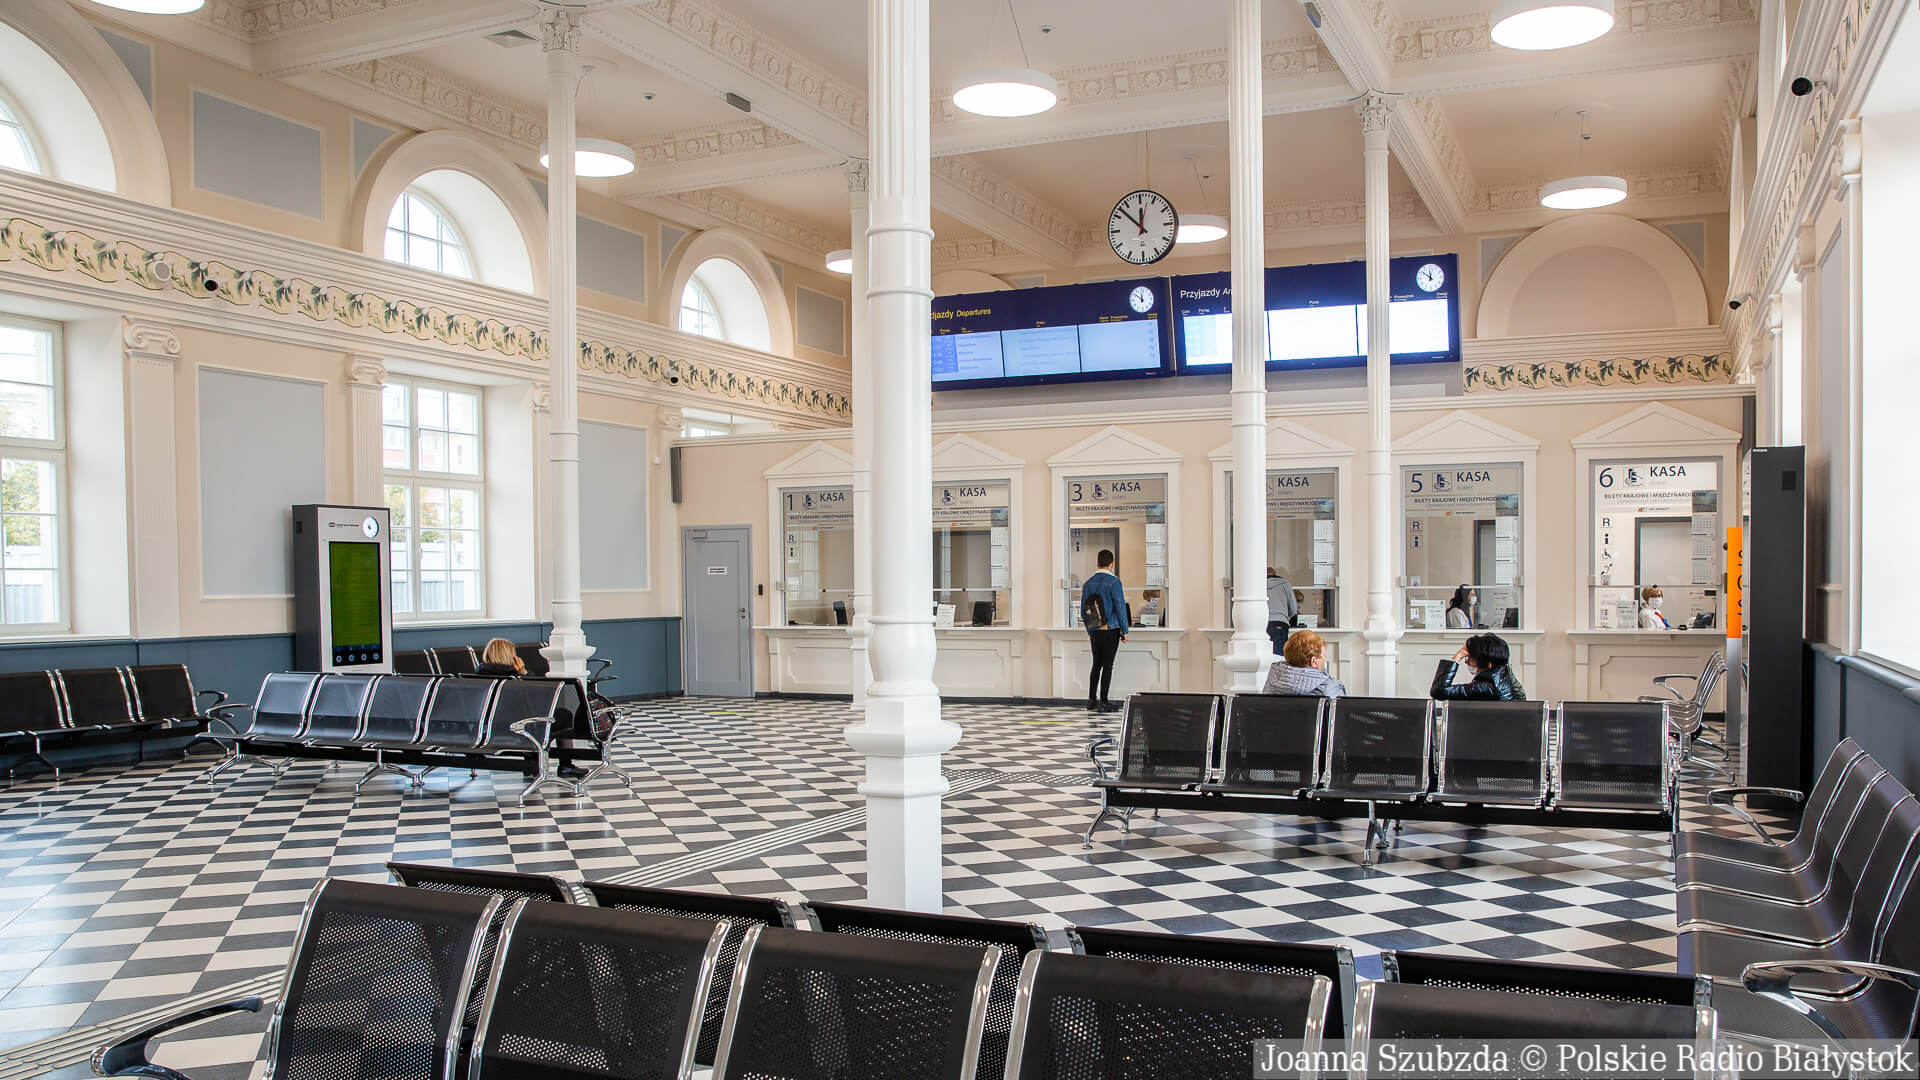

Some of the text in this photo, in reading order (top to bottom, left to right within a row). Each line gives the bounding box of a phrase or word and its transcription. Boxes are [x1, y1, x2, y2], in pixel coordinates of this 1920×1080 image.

[1180, 288, 1220, 300] Przyjazdy
[930, 308, 991, 320] djazdy Departures
[1278, 476, 1309, 487] KASA
[1410, 471, 1491, 493] 5 KASA
[1599, 465, 1686, 488] 6 KASA
[959, 487, 987, 497] KASA
[1071, 481, 1141, 502] 3 KASA
[786, 492, 845, 511] 1 KASA
[1602, 517, 1610, 526] R
